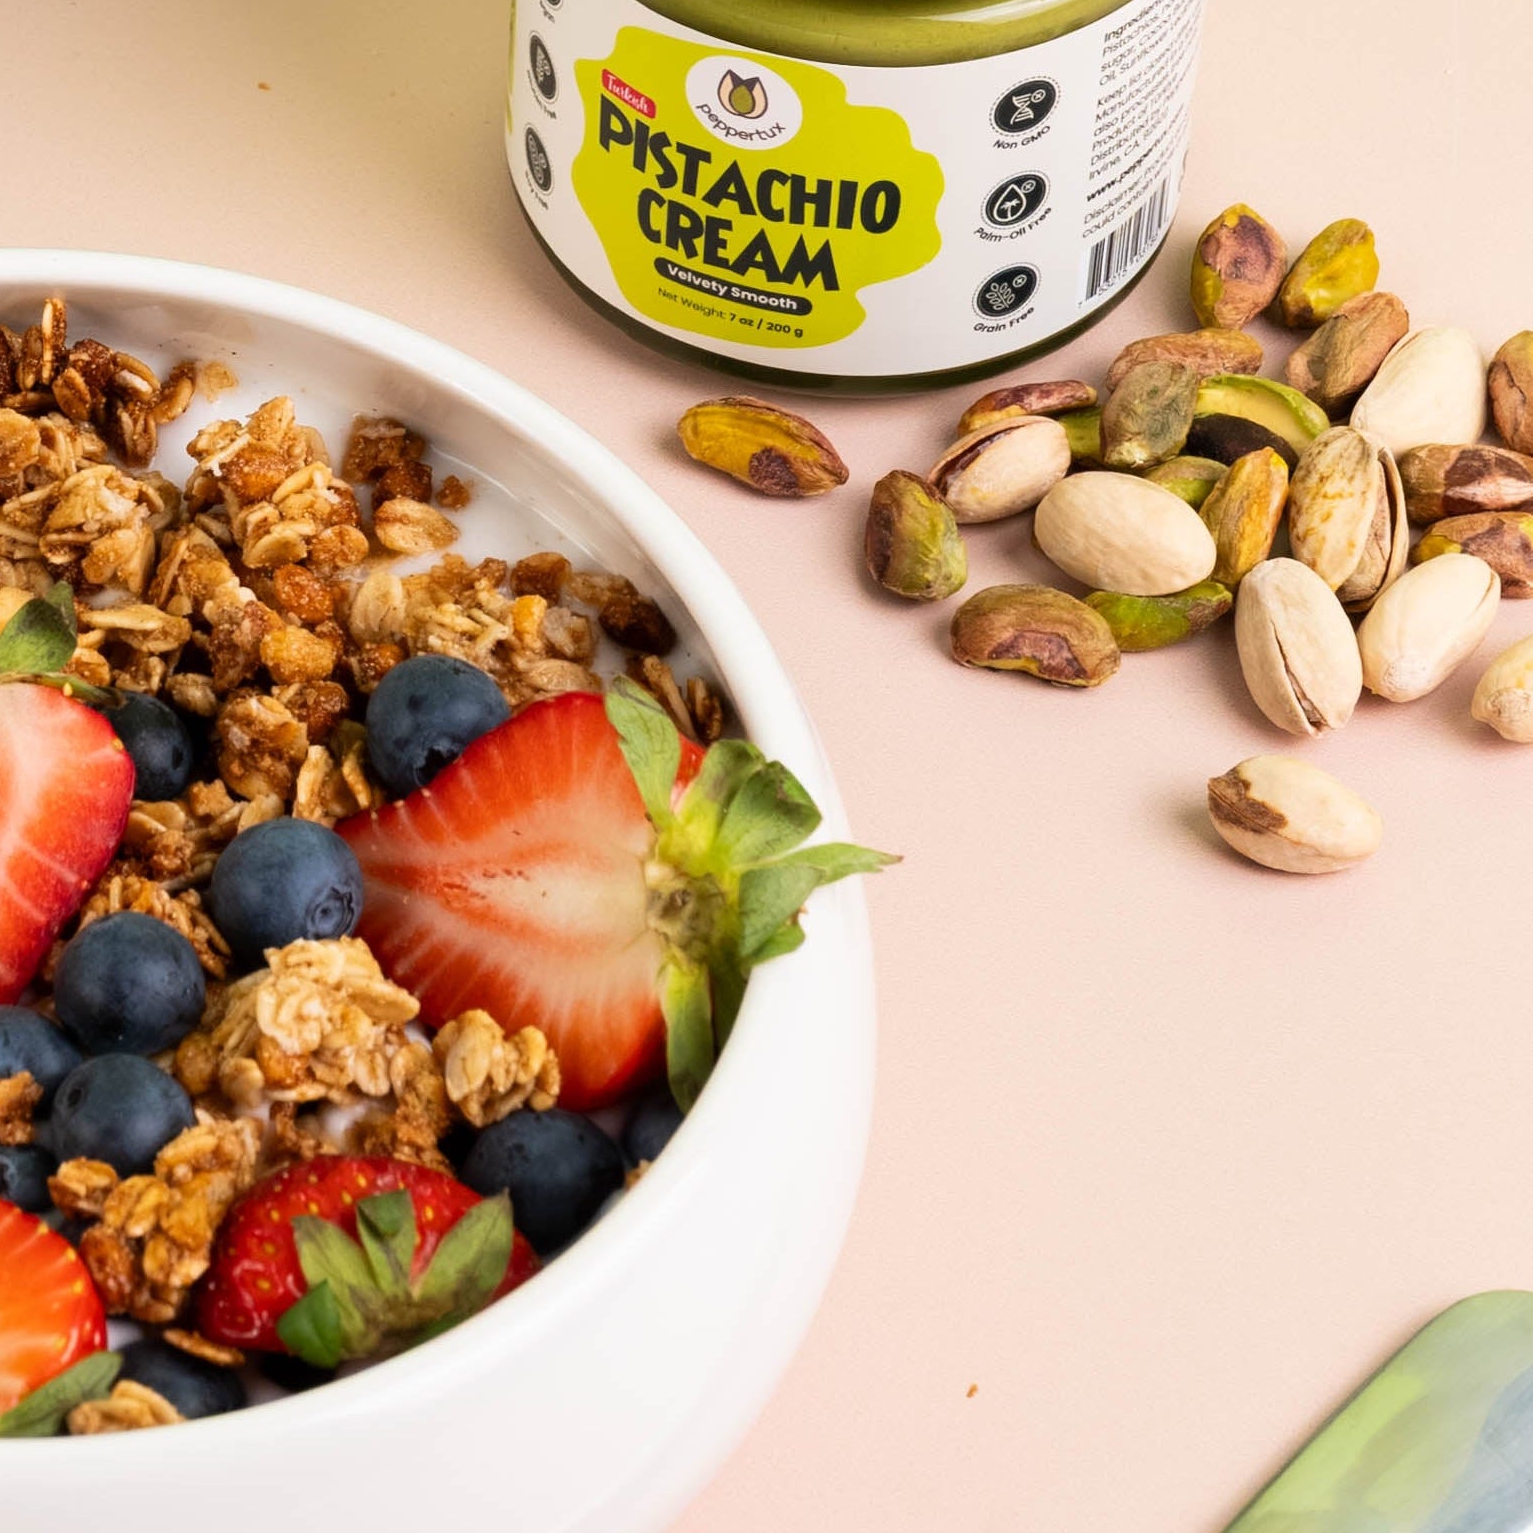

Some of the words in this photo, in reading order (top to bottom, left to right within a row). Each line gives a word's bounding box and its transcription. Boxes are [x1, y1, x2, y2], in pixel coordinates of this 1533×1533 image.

[605, 73, 651, 115] Turkish
[696, 103, 786, 141] peppertux
[993, 139, 1018, 150] Non
[1020, 125, 1051, 147] GMO
[598, 94, 901, 233] PISTACHIO
[637, 188, 840, 291] CREAM
[973, 226, 1026, 243] Palm-Oil
[1027, 207, 1052, 230] Free
[667, 263, 729, 297] Velvety
[730, 287, 799, 311] Smooth
[658, 287, 678, 303] Net
[729, 312, 737, 323] 7
[739, 317, 755, 328] oz
[757, 318, 764, 331] /
[767, 321, 791, 335] 200
[794, 328, 804, 339] g
[973, 322, 1007, 334] Grain
[1009, 306, 1035, 328] Free
